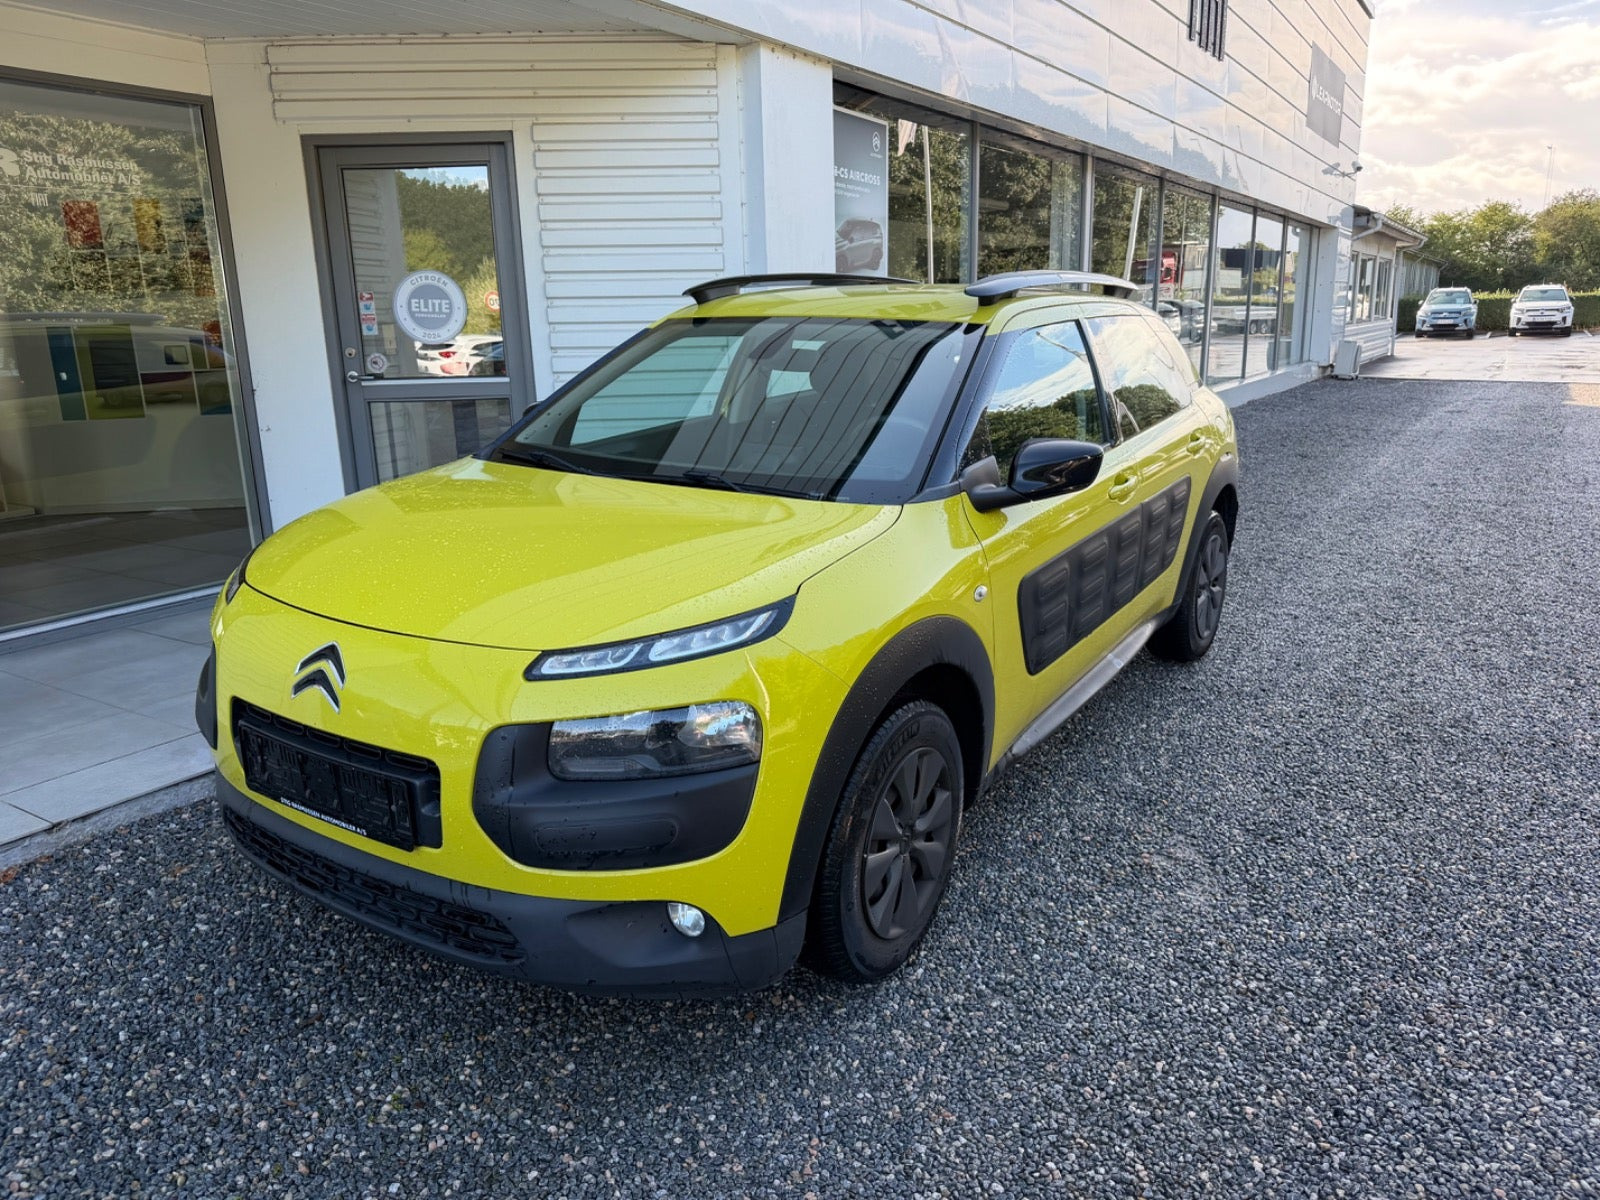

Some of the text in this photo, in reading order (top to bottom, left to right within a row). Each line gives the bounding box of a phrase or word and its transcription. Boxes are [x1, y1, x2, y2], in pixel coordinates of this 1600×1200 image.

[23, 150, 53, 167] Stig
[57, 153, 138, 171] Rasmussen
[26, 165, 141, 186] Automobiler A/S
[849, 169, 880, 186] AIRCROSS
[411, 298, 450, 313] ELITE
[422, 331, 442, 339] 2024
